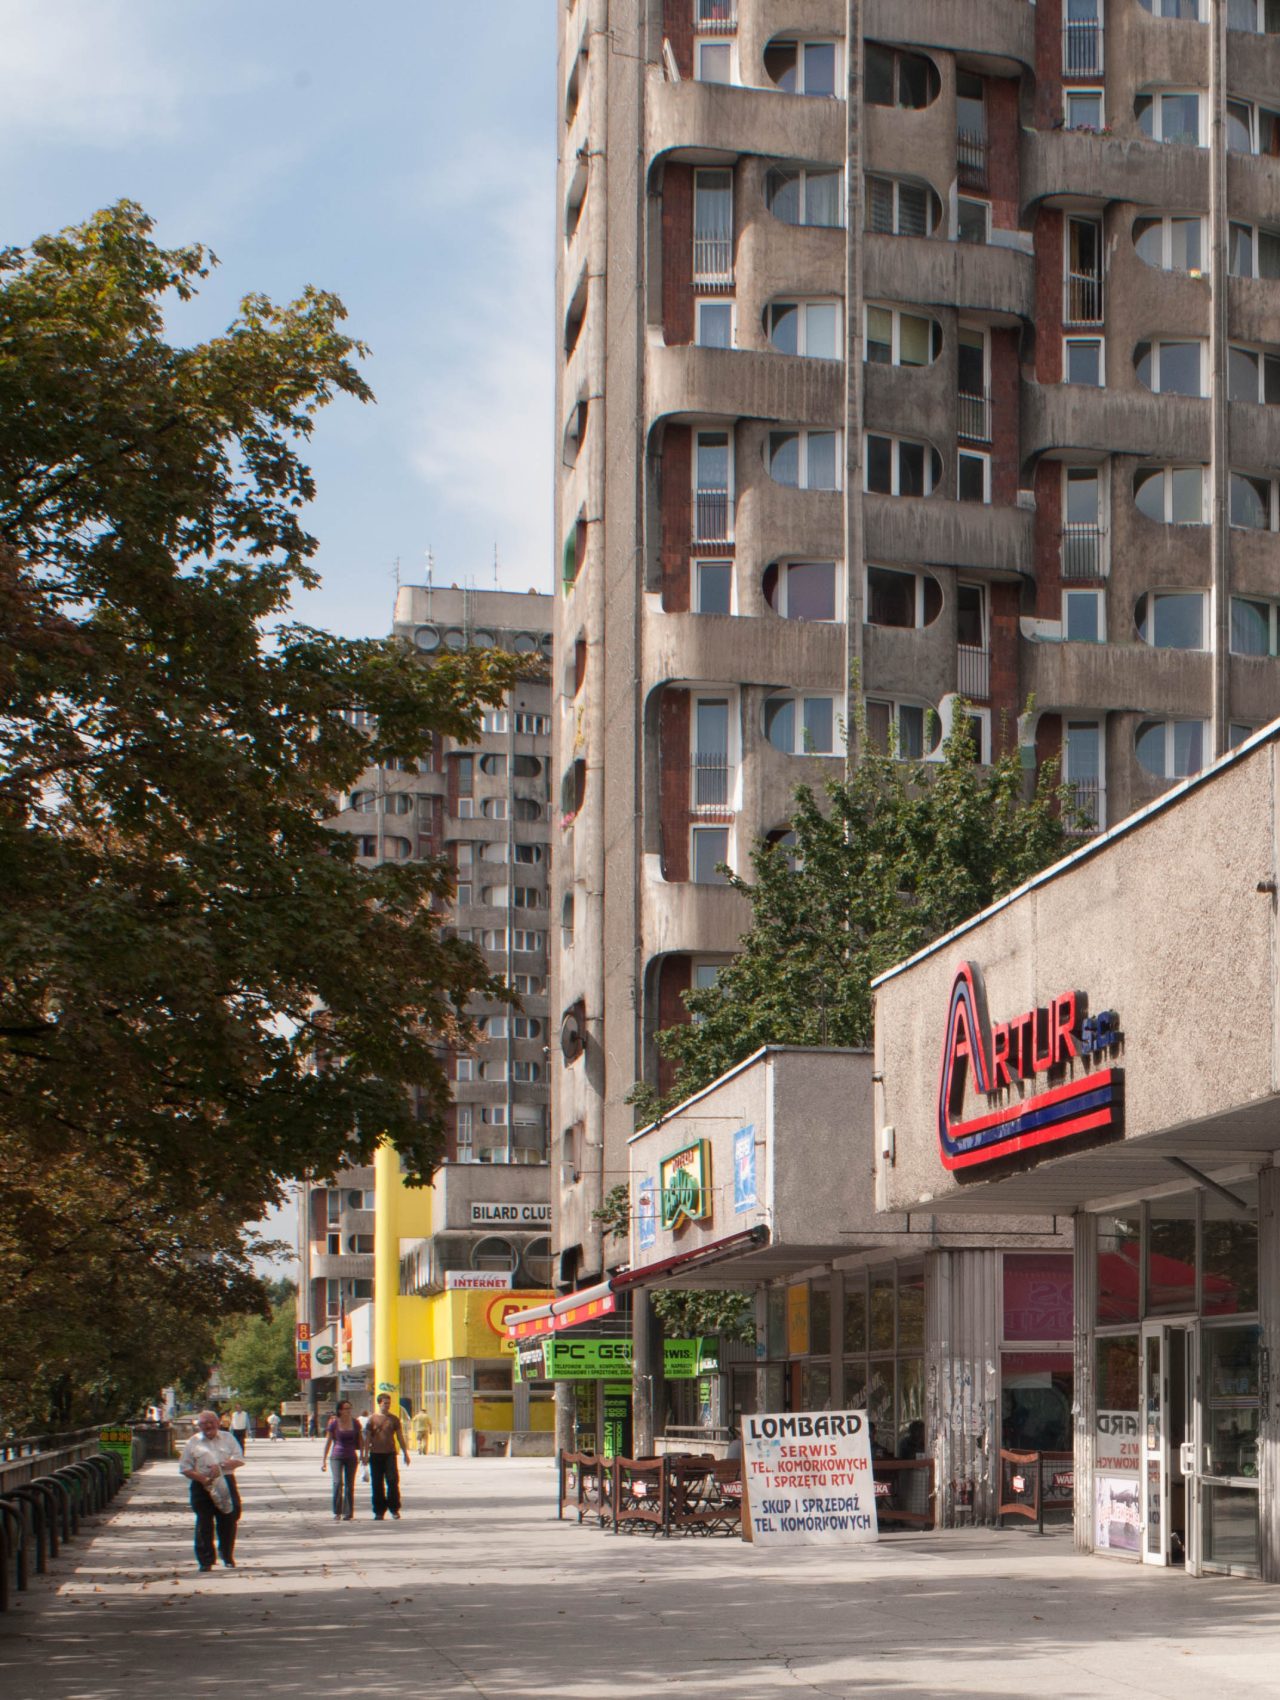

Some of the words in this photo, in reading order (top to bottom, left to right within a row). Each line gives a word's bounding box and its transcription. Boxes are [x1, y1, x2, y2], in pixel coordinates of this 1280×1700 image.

[472, 1206, 517, 1220] BILARD
[454, 1279, 507, 1288] INTERNET
[554, 1344, 585, 1358] PC
[750, 1415, 861, 1439] LOMBARD
[781, 1445, 837, 1457] SERWIS
[774, 1476, 827, 1489] SPRZĘTU
[831, 1474, 854, 1486] RTV
[723, 1484, 742, 1494] WAR
[762, 1500, 791, 1514] SKUP
[803, 1494, 860, 1514] SPRZEDAŻ
[755, 1518, 777, 1532] TEL.
[781, 1513, 871, 1532] KOMÓRKOWYCH
